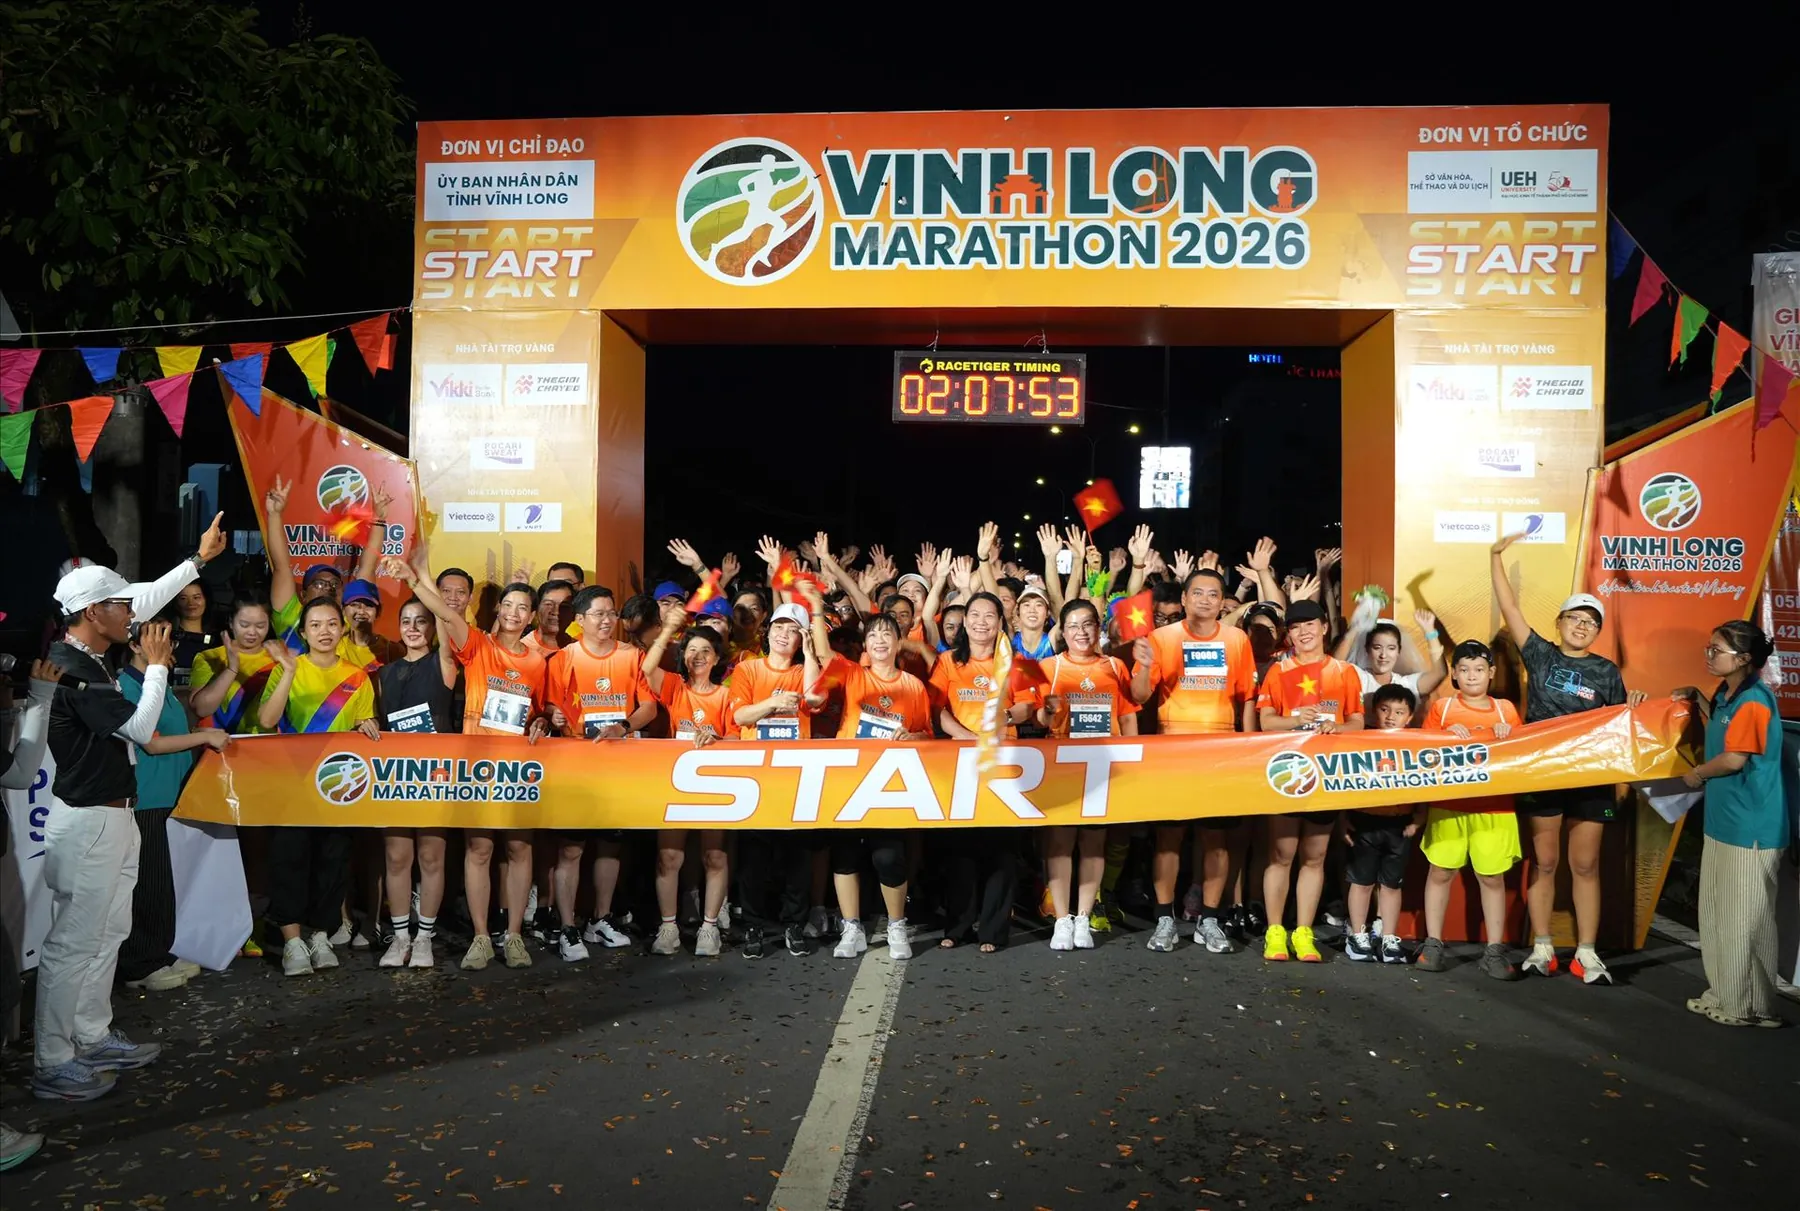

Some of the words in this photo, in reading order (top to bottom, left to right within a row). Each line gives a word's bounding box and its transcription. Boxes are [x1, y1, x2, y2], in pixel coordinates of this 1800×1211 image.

[1418, 127, 1462, 143] ĐƠN
[1468, 126, 1488, 146] VỊ
[1495, 121, 1522, 142] TỔ
[1527, 122, 1588, 142] CHỨC
[441, 139, 480, 156] ĐƠN
[486, 139, 504, 158] VỊ
[509, 134, 541, 154] CHỈ
[545, 137, 585, 157] ĐẠO
[438, 173, 457, 188] ỦY
[462, 176, 493, 188] BAN
[497, 173, 541, 187] NHÂN
[545, 172, 578, 187] DÂN
[826, 152, 1049, 215] VINH
[1069, 150, 1313, 214] LONG
[1471, 182, 1489, 191] LỊCH
[1501, 171, 1537, 186] UEH
[447, 191, 481, 206] TỈNH
[485, 190, 522, 205] VĨNH
[527, 193, 568, 205] LONG
[834, 224, 1156, 266] MARATHON
[1172, 222, 1306, 265] 2026
[422, 250, 594, 278] START
[1406, 245, 1597, 274] START
[525, 343, 554, 353] VÀNG
[1522, 342, 1555, 354] VÀNG
[936, 361, 1010, 372] RACETIGER
[1013, 362, 1061, 373] TIMING
[429, 373, 474, 398] Vikki
[900, 375, 1079, 417] 02:07:53
[1602, 537, 1666, 556] VINH
[1673, 538, 1744, 557] LONG
[1603, 558, 1698, 571] MARATHON
[1702, 559, 1741, 571] 2026
[397, 715, 423, 731] F5258
[372, 758, 450, 782] VINH
[458, 760, 543, 784] LONG
[1317, 751, 1397, 776] VINH
[1402, 744, 1488, 771] LONG
[664, 744, 1144, 823] START
[1324, 771, 1437, 791] MARATHON
[1442, 768, 1488, 785] 2026
[373, 785, 487, 800] MARATHON
[493, 785, 539, 801] 2026
